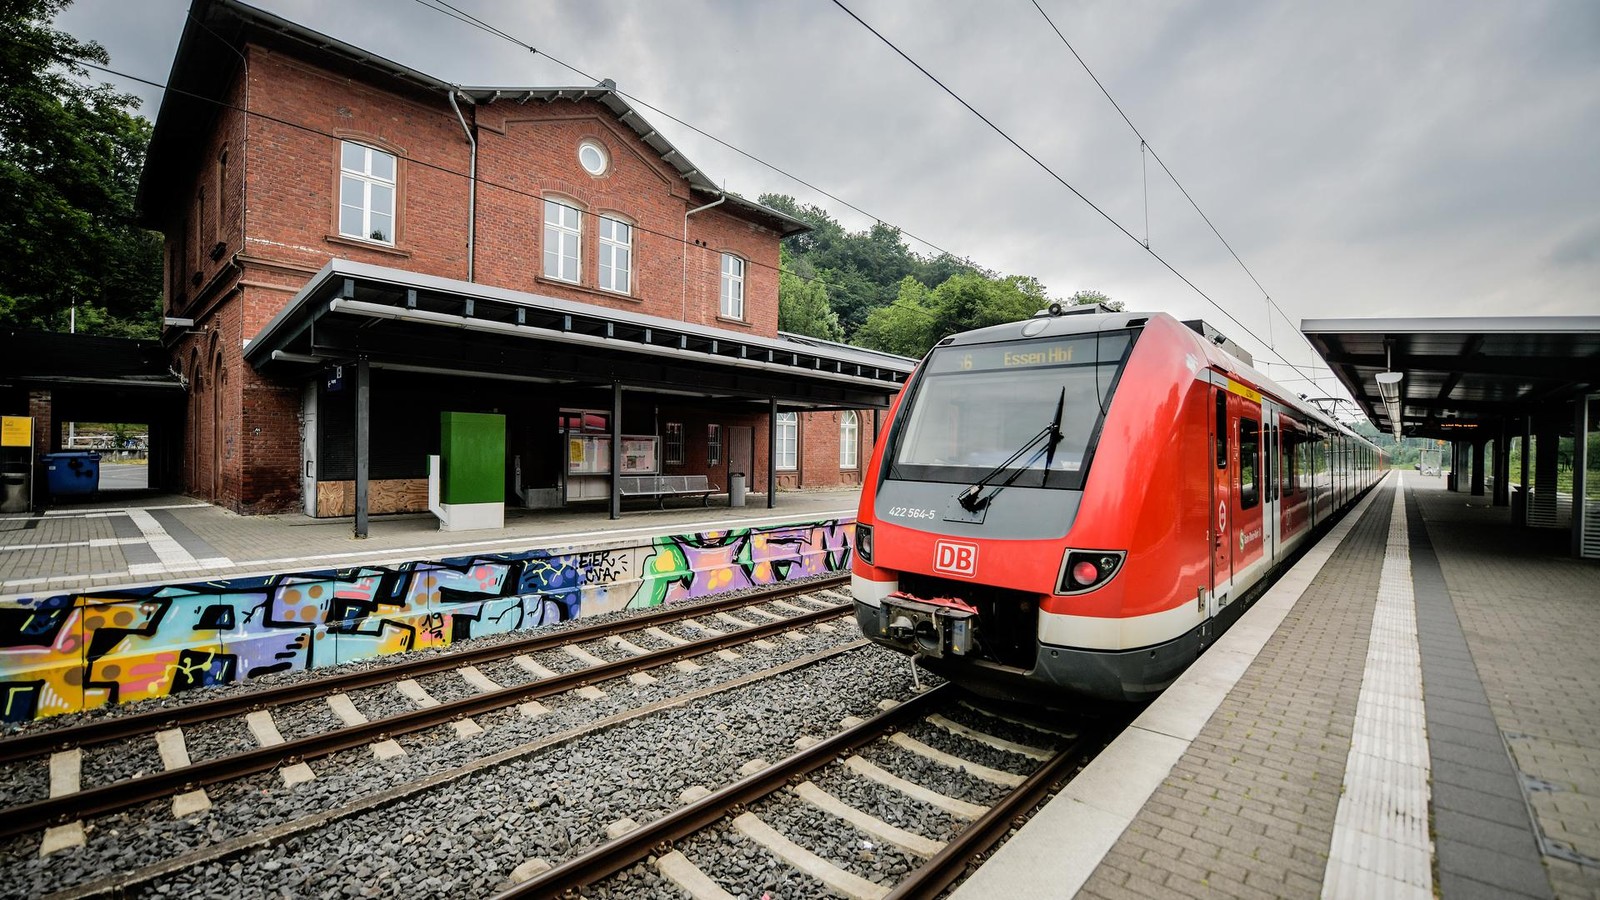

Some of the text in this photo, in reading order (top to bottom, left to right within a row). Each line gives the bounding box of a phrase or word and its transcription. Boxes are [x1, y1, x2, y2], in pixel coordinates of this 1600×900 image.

[1004, 351, 1046, 367] Essen
[1048, 345, 1074, 364] Hbf
[888, 506, 937, 520] 422 564-5
[939, 545, 972, 571] DB
